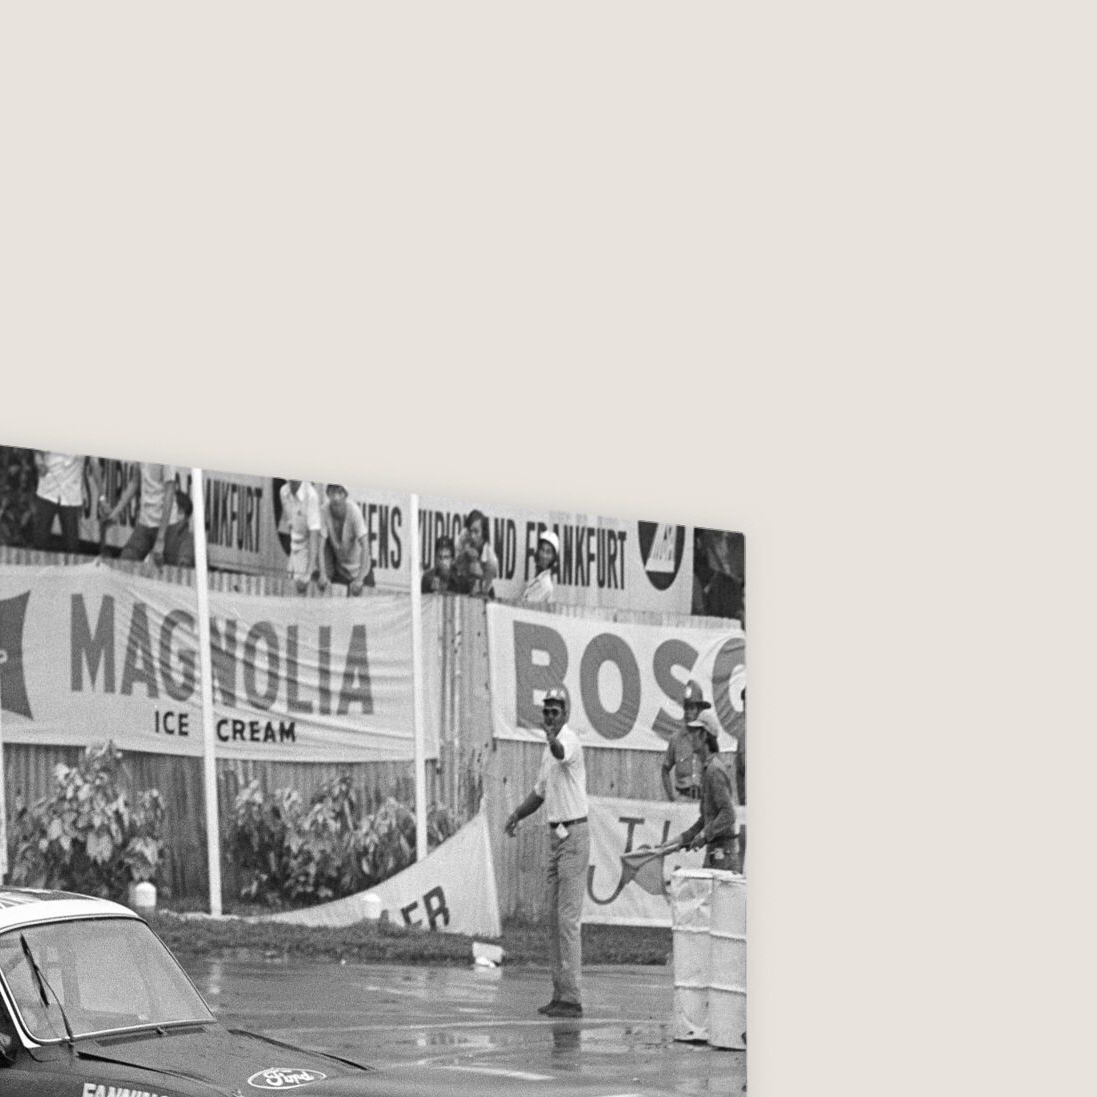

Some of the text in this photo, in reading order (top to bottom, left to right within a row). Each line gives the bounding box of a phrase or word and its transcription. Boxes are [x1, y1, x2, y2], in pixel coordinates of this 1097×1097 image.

[357, 502, 402, 569] ENS
[486, 517, 516, 580] ND
[523, 519, 627, 590] FANKFURT
[70, 593, 374, 715] MAGNOLIA
[155, 711, 296, 743] ICE CREAM
[262, 1067, 314, 1086] Ford
